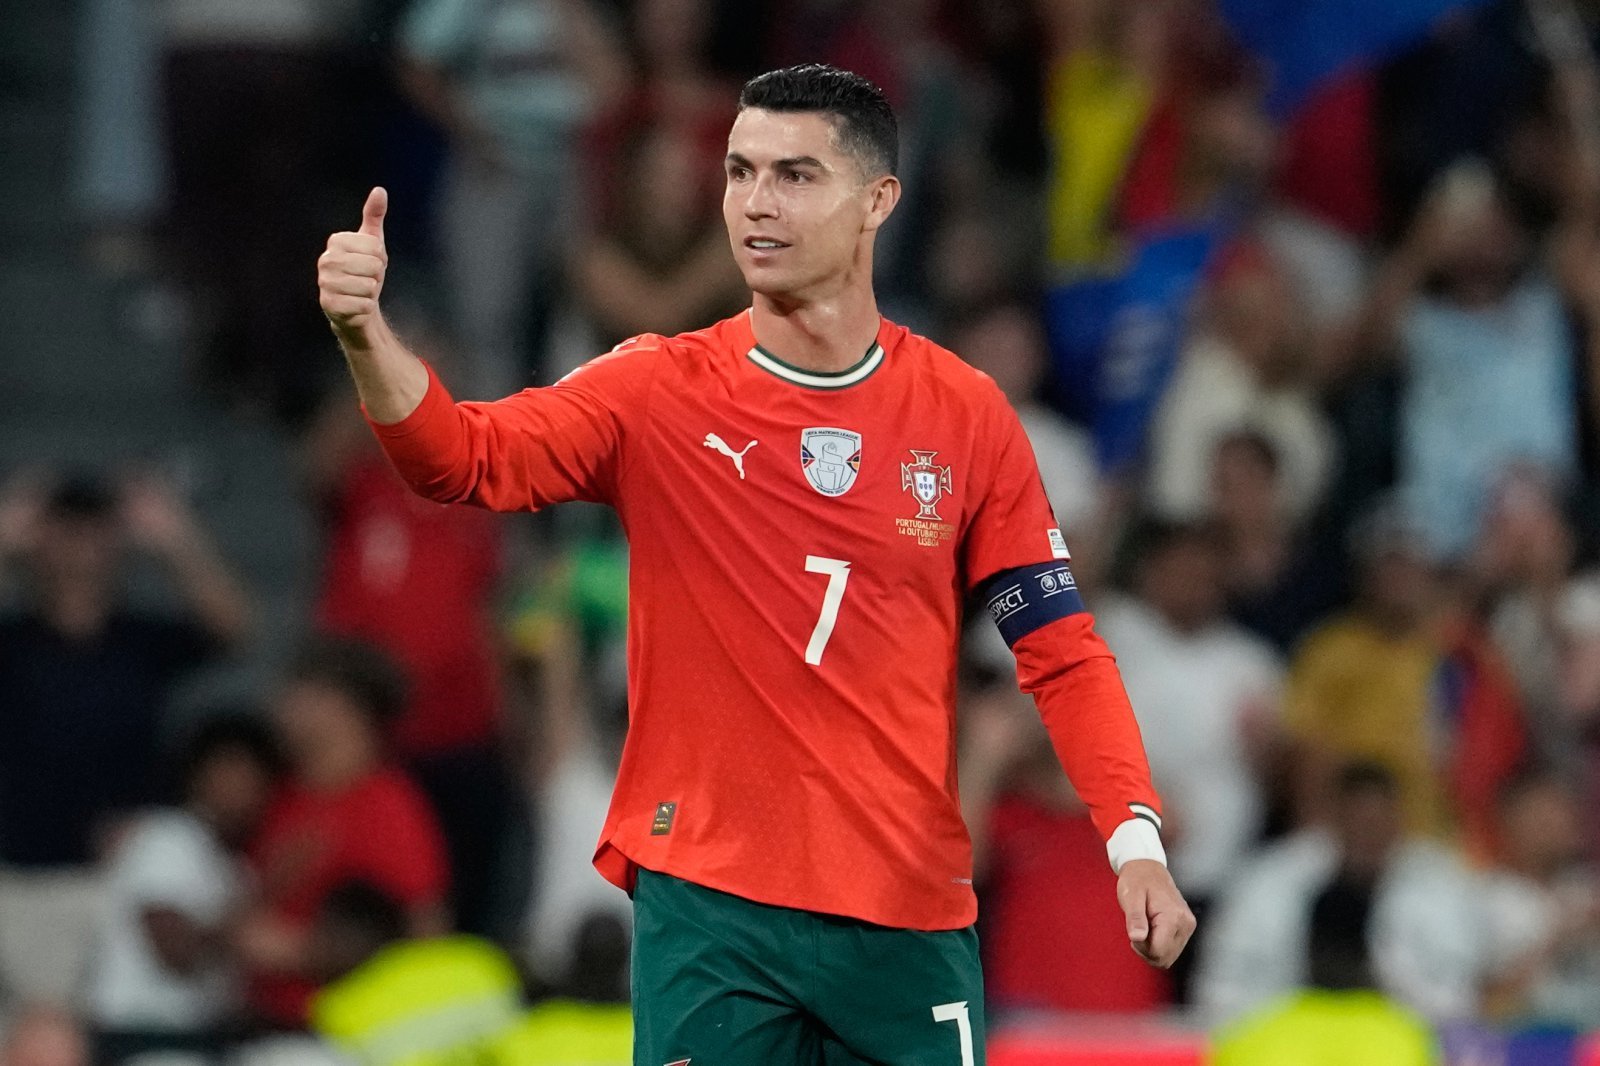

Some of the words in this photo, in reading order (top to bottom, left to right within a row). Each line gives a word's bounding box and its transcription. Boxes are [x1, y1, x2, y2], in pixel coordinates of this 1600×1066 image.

[898, 527, 905, 535] 14
[906, 528, 938, 538] OUTUBRO
[917, 537, 939, 546] LISBOA
[805, 555, 851, 666] 7
[932, 1001, 974, 1066] 7
